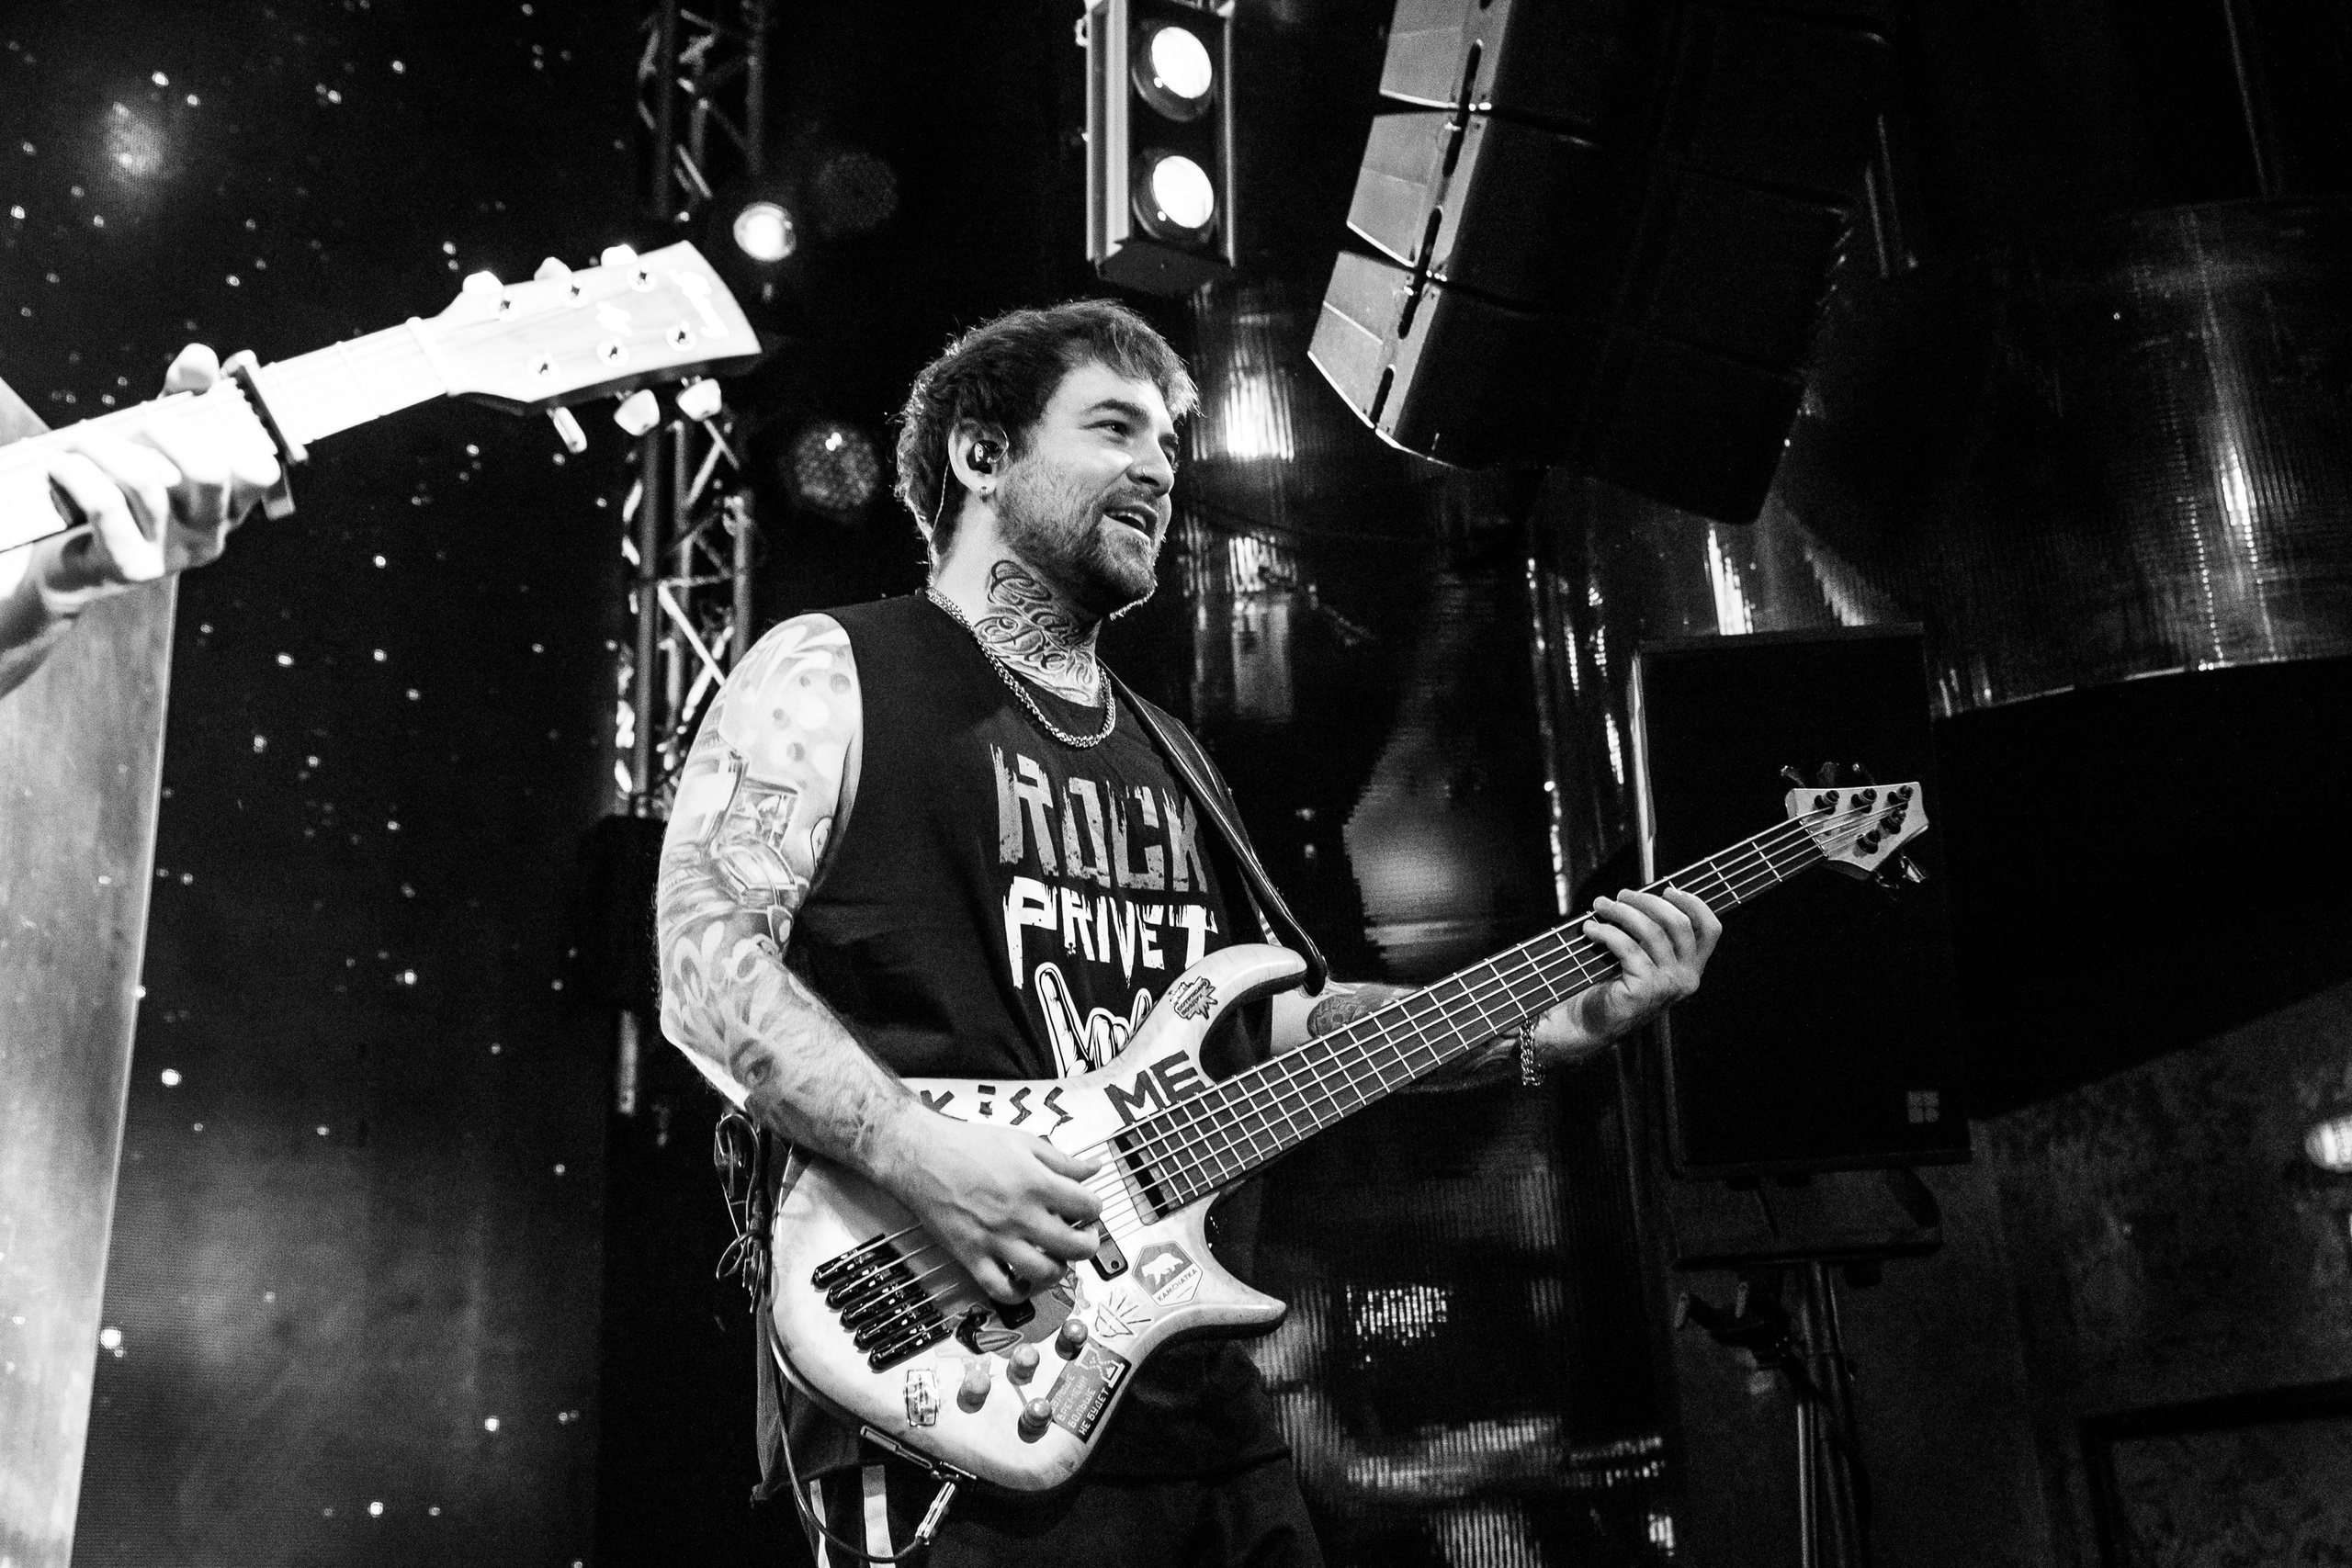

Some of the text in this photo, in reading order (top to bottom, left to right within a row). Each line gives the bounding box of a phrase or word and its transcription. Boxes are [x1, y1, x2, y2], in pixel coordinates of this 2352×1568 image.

[989, 743, 1208, 893] ROCK
[1002, 875, 1219, 990] PRIVET
[1102, 1049, 1213, 1126] ME
[1157, 1269, 1197, 1302] KAMCHATKA
[1068, 1387, 1096, 1428] БОЛЬШЕ
[1079, 1387, 1109, 1436] НЕ БУДЕТ
